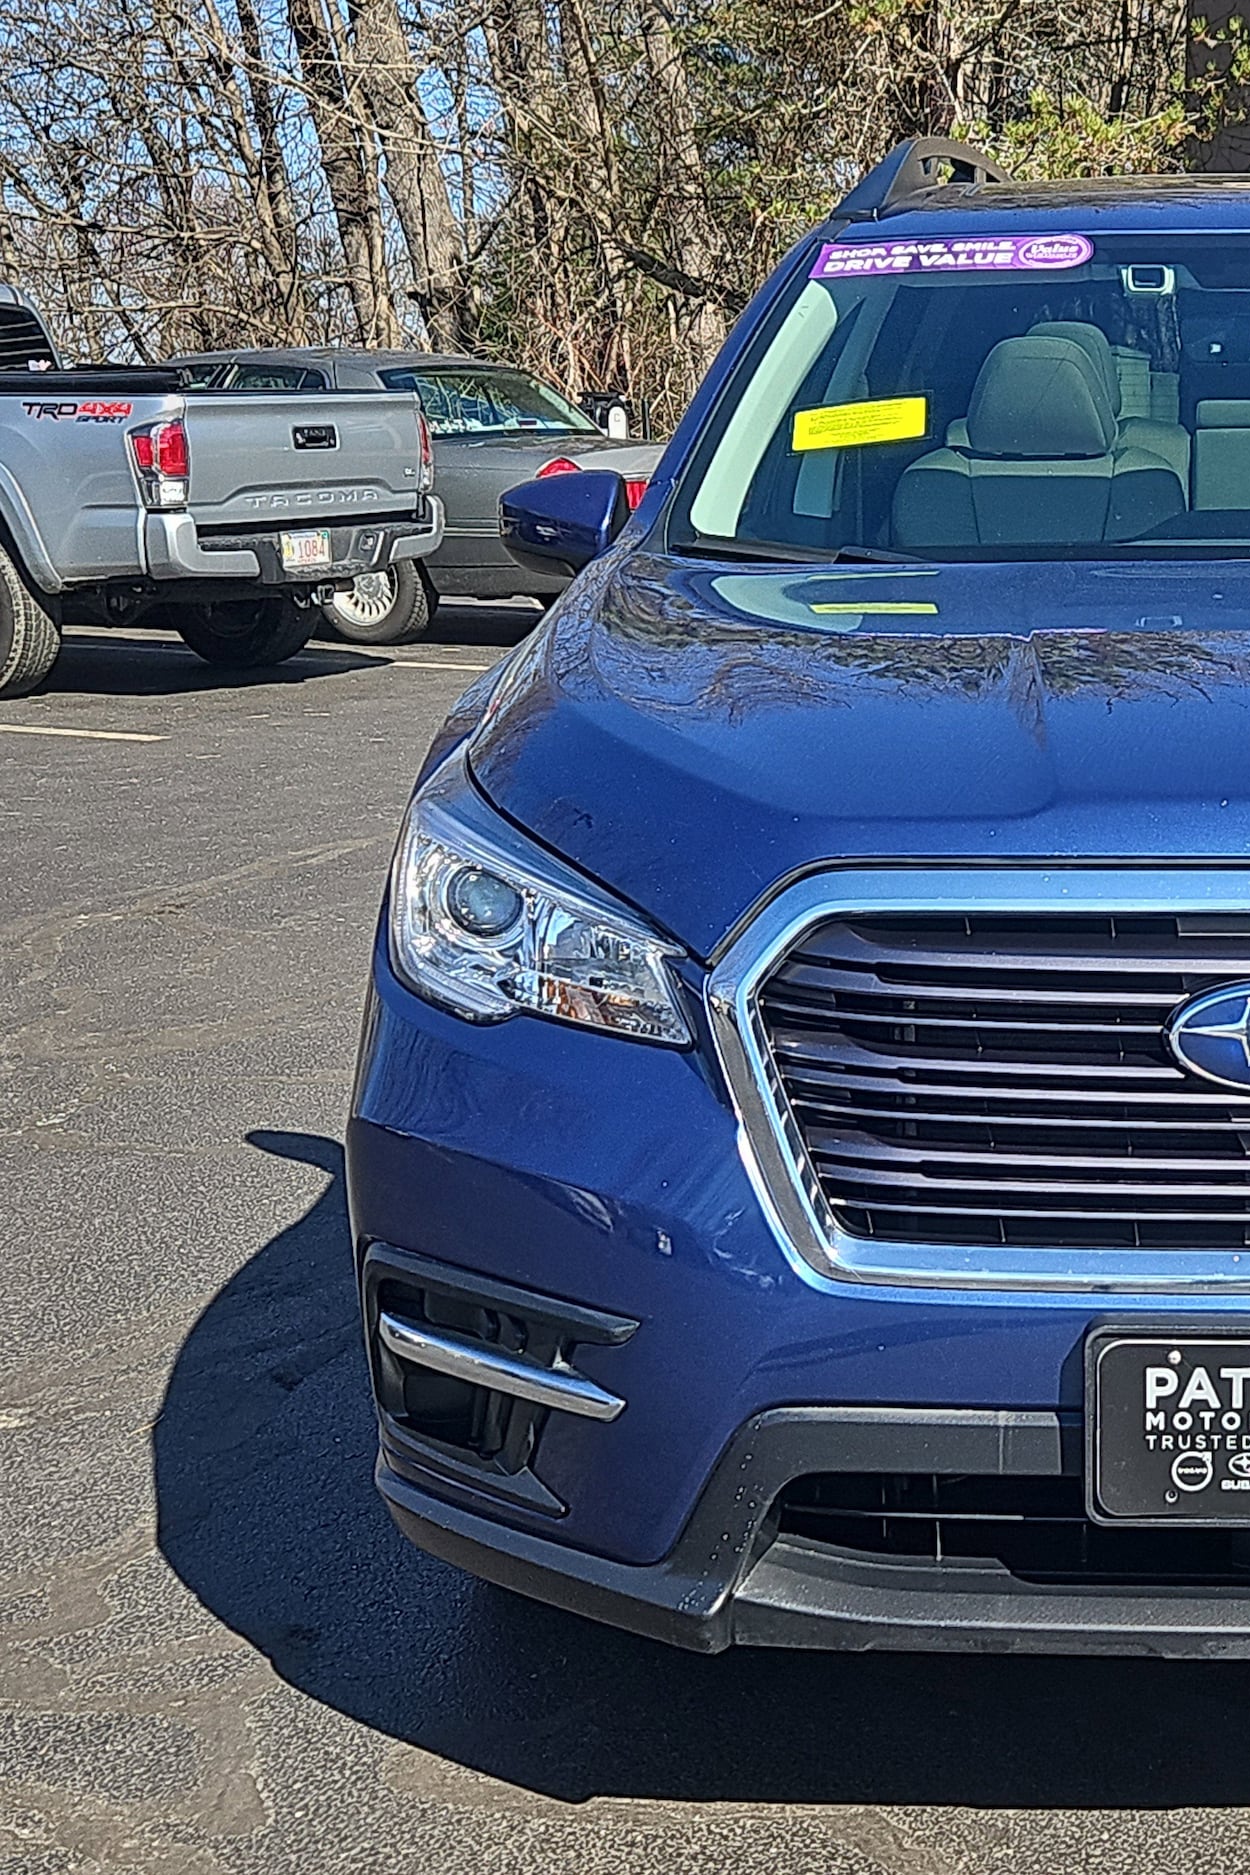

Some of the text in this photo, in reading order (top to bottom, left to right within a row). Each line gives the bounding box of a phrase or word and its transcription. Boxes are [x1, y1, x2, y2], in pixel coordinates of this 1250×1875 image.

[823, 251, 1015, 274] DRIVE VALUE
[22, 401, 79, 421] TRD
[75, 415, 128, 424] SPORT
[244, 489, 379, 509] TACOMA
